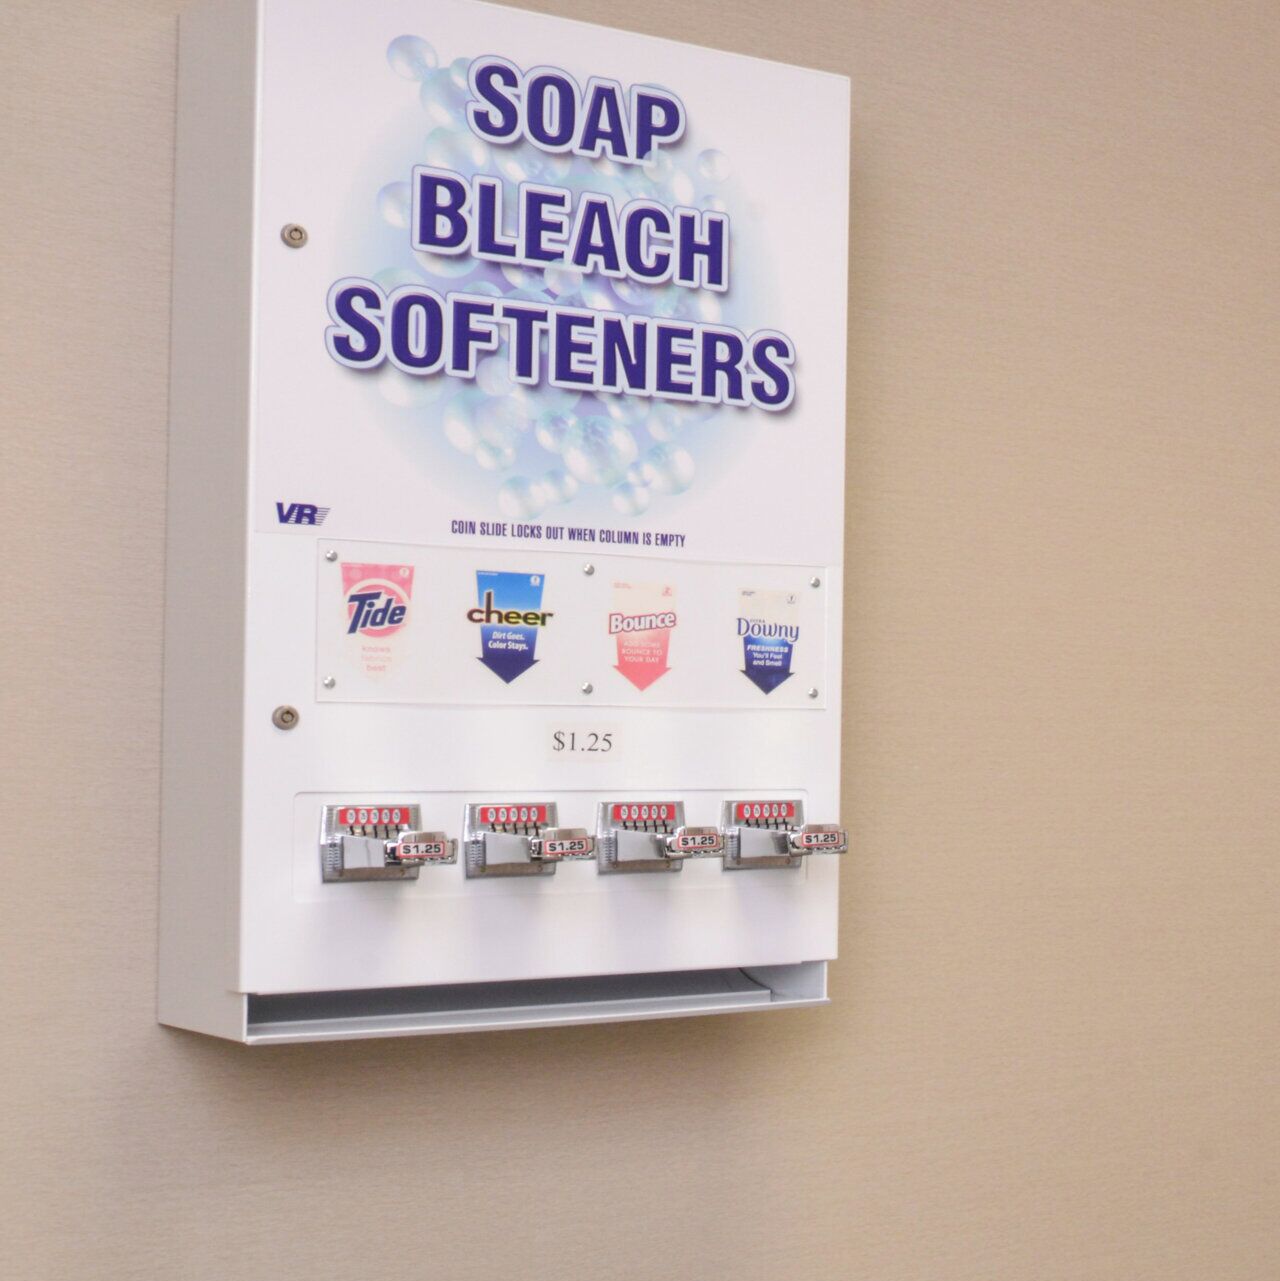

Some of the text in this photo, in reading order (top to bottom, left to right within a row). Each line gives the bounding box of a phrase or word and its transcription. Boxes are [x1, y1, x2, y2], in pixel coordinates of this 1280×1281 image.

[470, 58, 683, 161] SOAP
[416, 171, 728, 288] BLEACH
[330, 285, 793, 408] SOFTENERS
[451, 520, 686, 547] COIN SLIDE LOCKS OUT WHEN COLUMN IS EMPTY
[347, 592, 406, 635] Tide
[467, 591, 553, 626] cheer
[609, 613, 676, 634] Bounce
[488, 640, 528, 651] Color Stays.
[736, 618, 799, 642] Downy
[552, 730, 613, 753] $1.25
